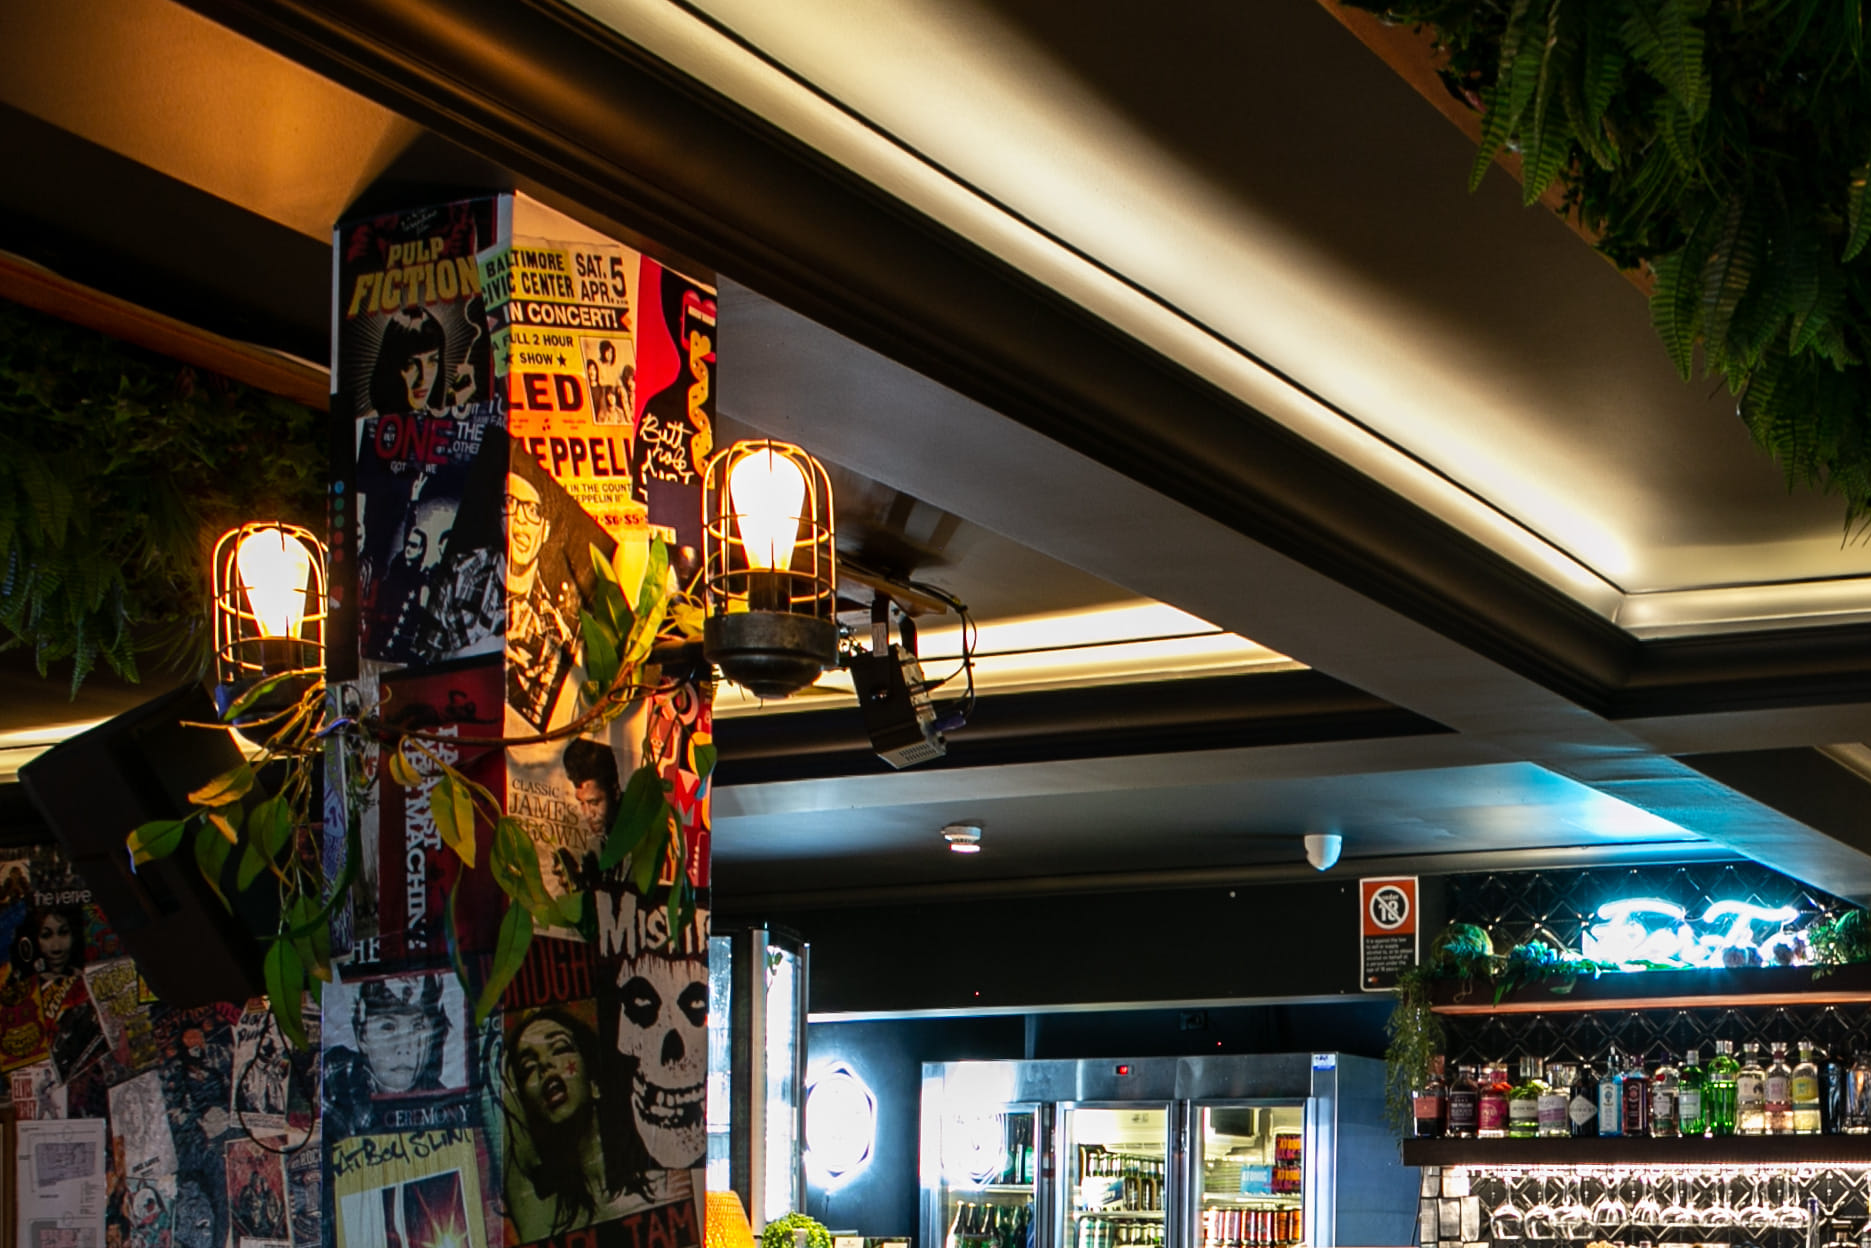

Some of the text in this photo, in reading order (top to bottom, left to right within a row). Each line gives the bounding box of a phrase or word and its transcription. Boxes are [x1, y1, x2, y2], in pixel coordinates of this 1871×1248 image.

[386, 236, 445, 268] PULP
[486, 250, 565, 278] BALTIMORE
[576, 253, 606, 279] SAT.
[610, 256, 627, 298] 5
[347, 253, 482, 320] FICTION
[522, 272, 575, 298] CENTER
[581, 280, 615, 304] APR.
[504, 299, 618, 328] IN CONCERT!
[533, 333, 540, 346] 2
[543, 334, 574, 348] HOUR
[519, 351, 554, 365] SHOW
[373, 413, 452, 464] ONE
[457, 421, 486, 441] THE
[581, 483, 599, 494] THE
[512, 779, 560, 798] CLASSIC
[509, 793, 579, 825] JAMES
[34, 888, 92, 906] the verve
[1378, 901, 1399, 921] 18
[384, 1104, 470, 1127] CEREMONY
